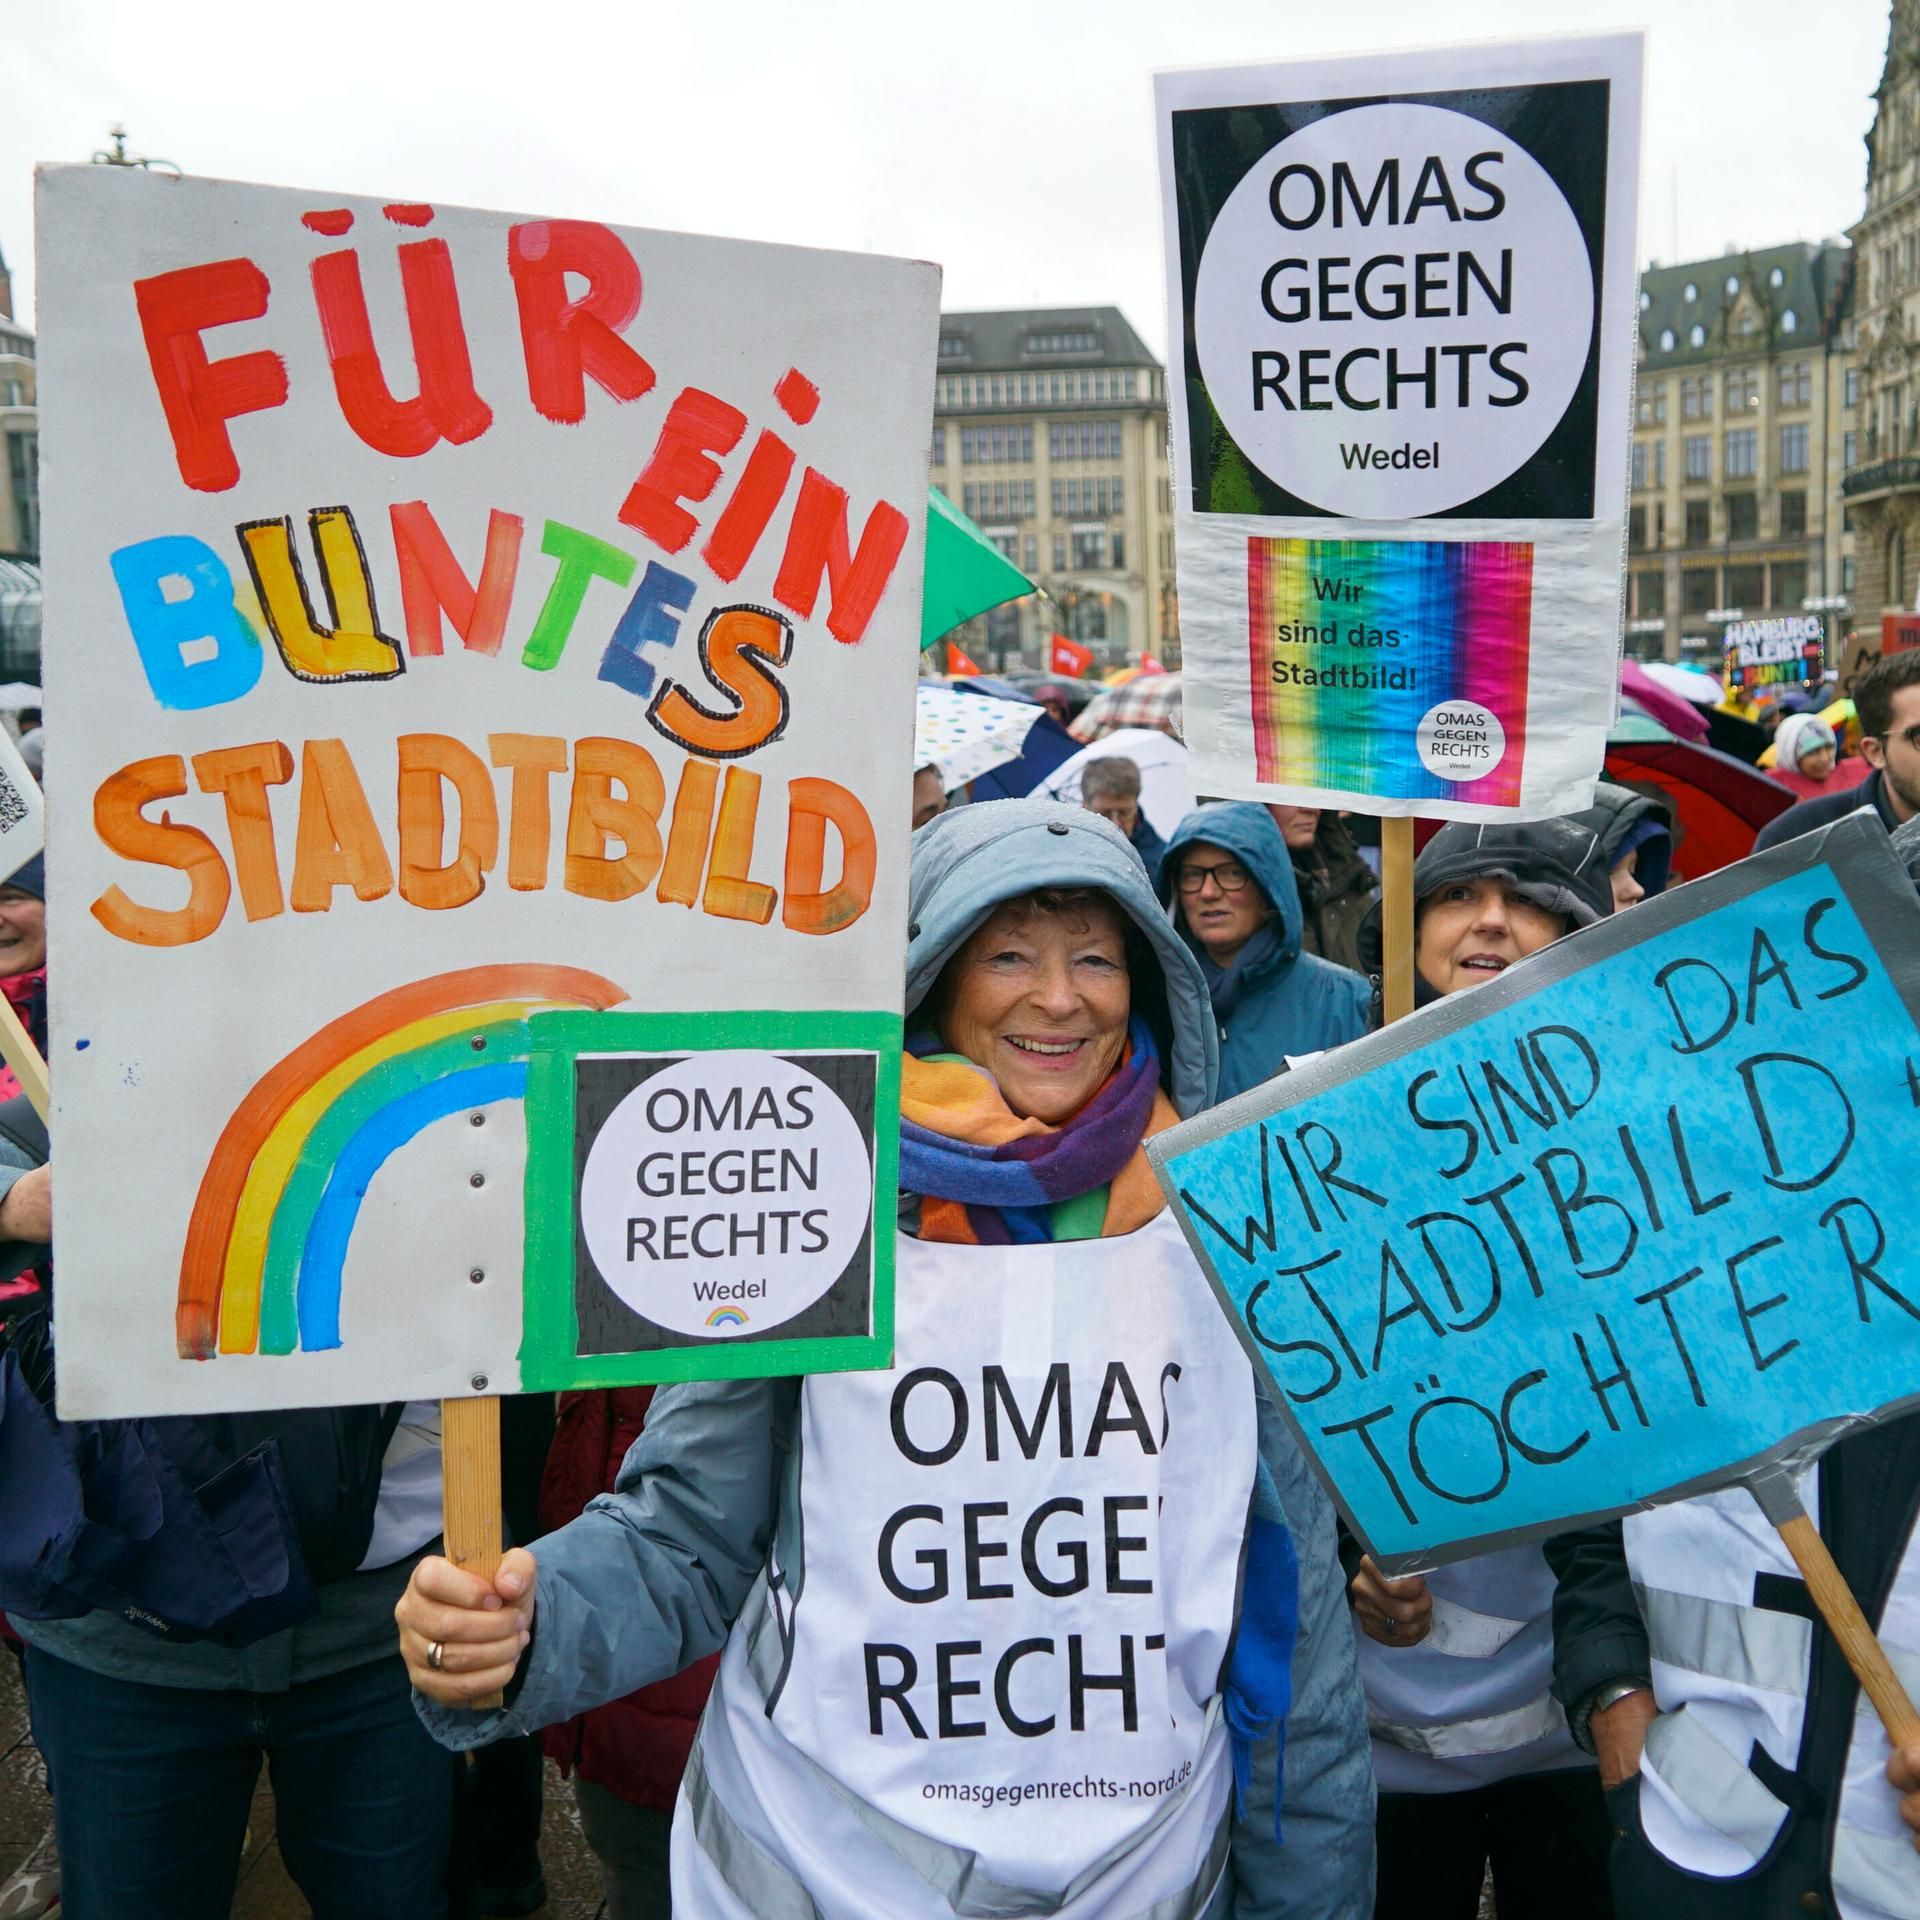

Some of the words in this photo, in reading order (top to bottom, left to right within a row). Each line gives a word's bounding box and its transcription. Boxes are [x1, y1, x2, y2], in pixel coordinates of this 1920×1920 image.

[1268, 151, 1506, 231] OMAS
[1260, 248, 1513, 323] GEGEN
[1251, 342, 1530, 411] RECHTS
[134, 203, 657, 493] FÜR
[617, 367, 909, 646] EIN
[1339, 441, 1440, 470] Wedel
[1312, 576, 1364, 603] Wir
[110, 499, 795, 759] BUNTES
[1278, 619, 1338, 645] sind
[1347, 622, 1401, 648] das
[1271, 660, 1417, 691] Stadtbild!
[1433, 729, 1487, 742] GEGEN
[1435, 712, 1486, 727] OMAS
[1431, 742, 1491, 759] RECHTS
[1448, 762, 1471, 770] Wedel
[90, 732, 877, 947] STADTBILD
[1180, 1121, 1388, 1265] WIR
[1407, 1023, 1601, 1180] SIND
[1653, 897, 1869, 1055] DAS
[646, 1085, 814, 1133] OMAS
[636, 1148, 818, 1197] GEGEN
[626, 1209, 829, 1262] RECHTS
[1244, 1051, 1855, 1404] STADTBILD
[693, 1279, 767, 1301] Wedel
[1321, 1197, 1920, 1526] TÖCHTER
[877, 1496, 1164, 1604] GEGE
[863, 1633, 1176, 1739] RECH
[922, 1760, 1192, 1808] omasgegenrechts-nord.de
